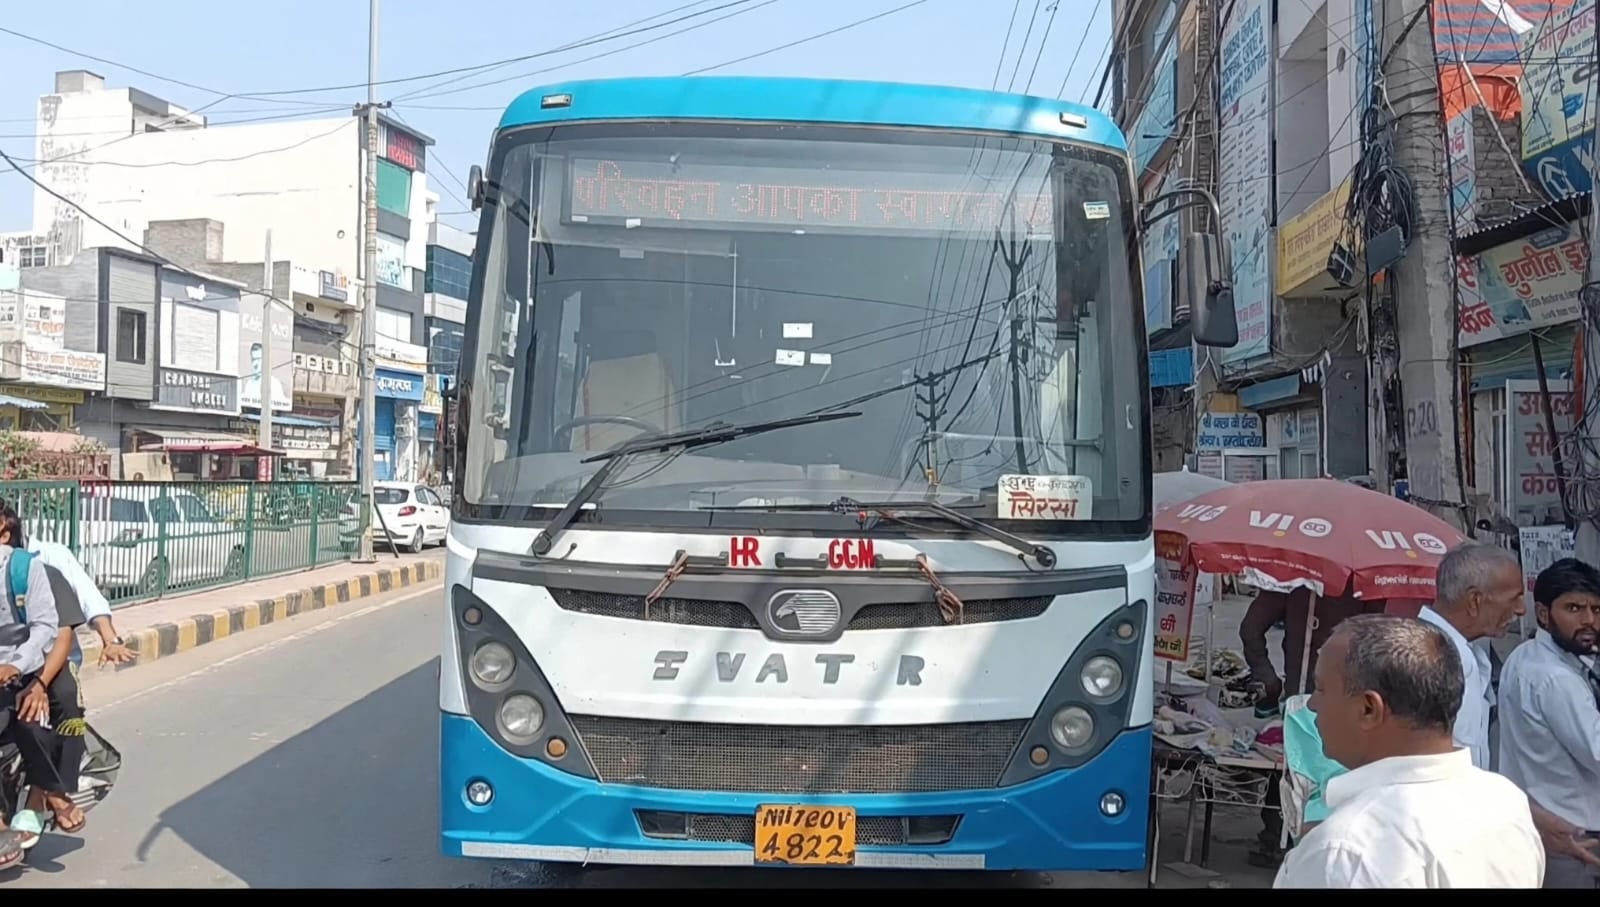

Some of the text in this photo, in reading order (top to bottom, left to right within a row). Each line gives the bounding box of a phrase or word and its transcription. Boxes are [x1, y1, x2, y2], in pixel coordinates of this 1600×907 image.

[732, 183, 862, 220] आपका
[1008, 491, 1079, 519] सिरसा
[731, 536, 876, 569] HR GGM
[762, 831, 843, 861] 4822
